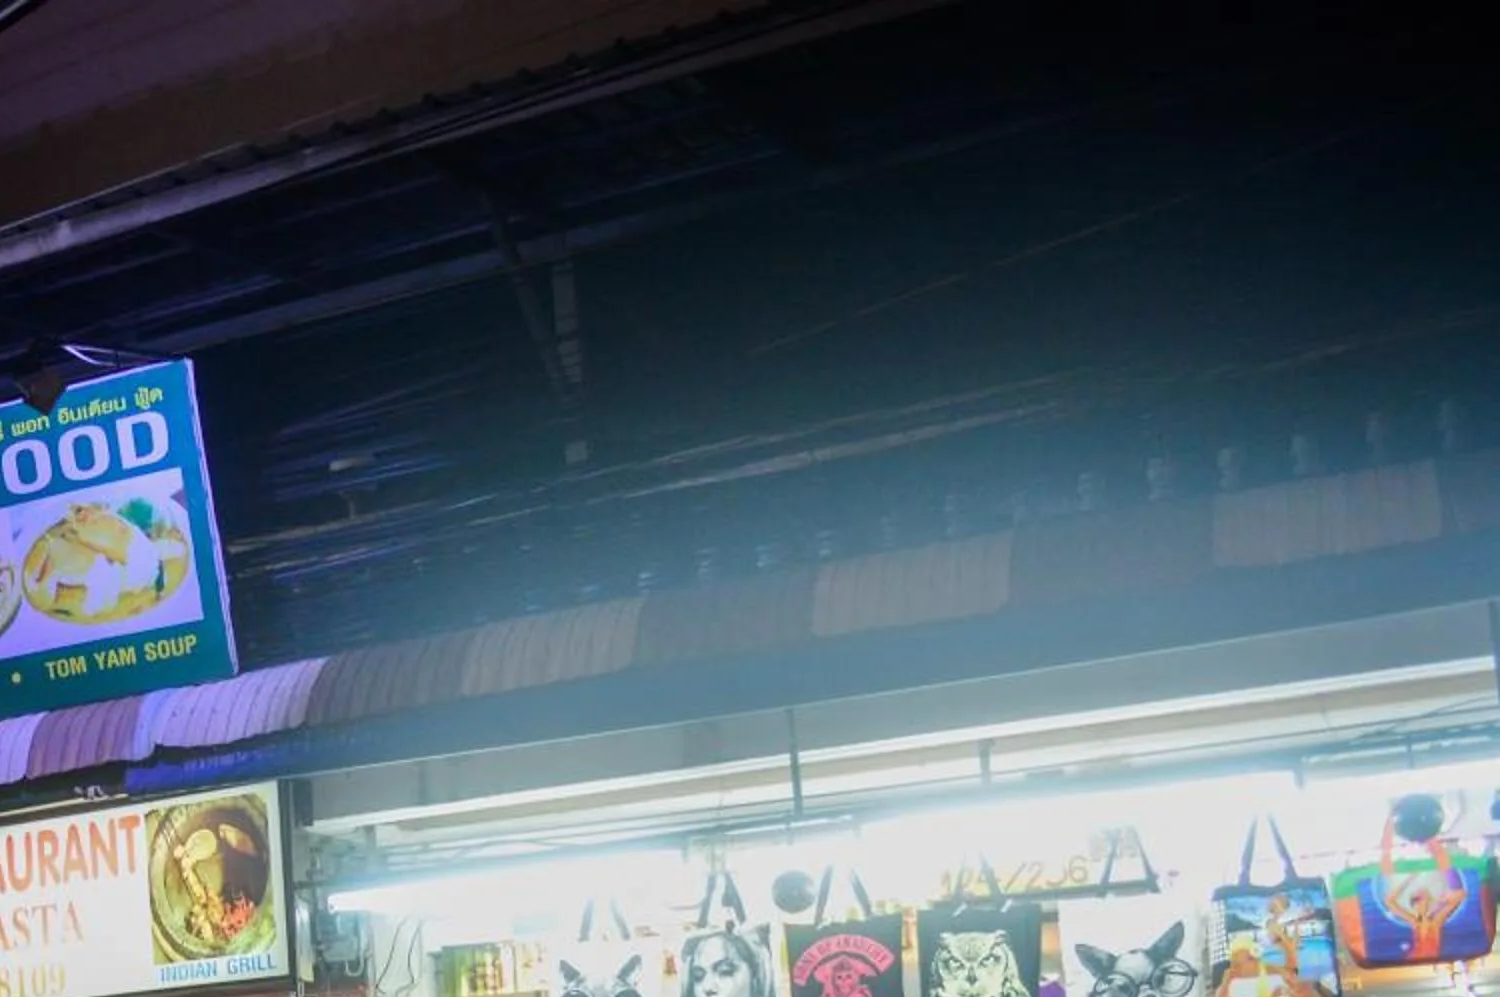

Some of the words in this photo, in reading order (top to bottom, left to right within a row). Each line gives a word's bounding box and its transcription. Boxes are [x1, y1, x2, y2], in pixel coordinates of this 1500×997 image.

[44, 656, 87, 681] TOM
[93, 645, 137, 672] YAM
[143, 634, 198, 661] SOUP
[159, 960, 218, 983] INDIAN
[226, 954, 278, 976] GRILL
